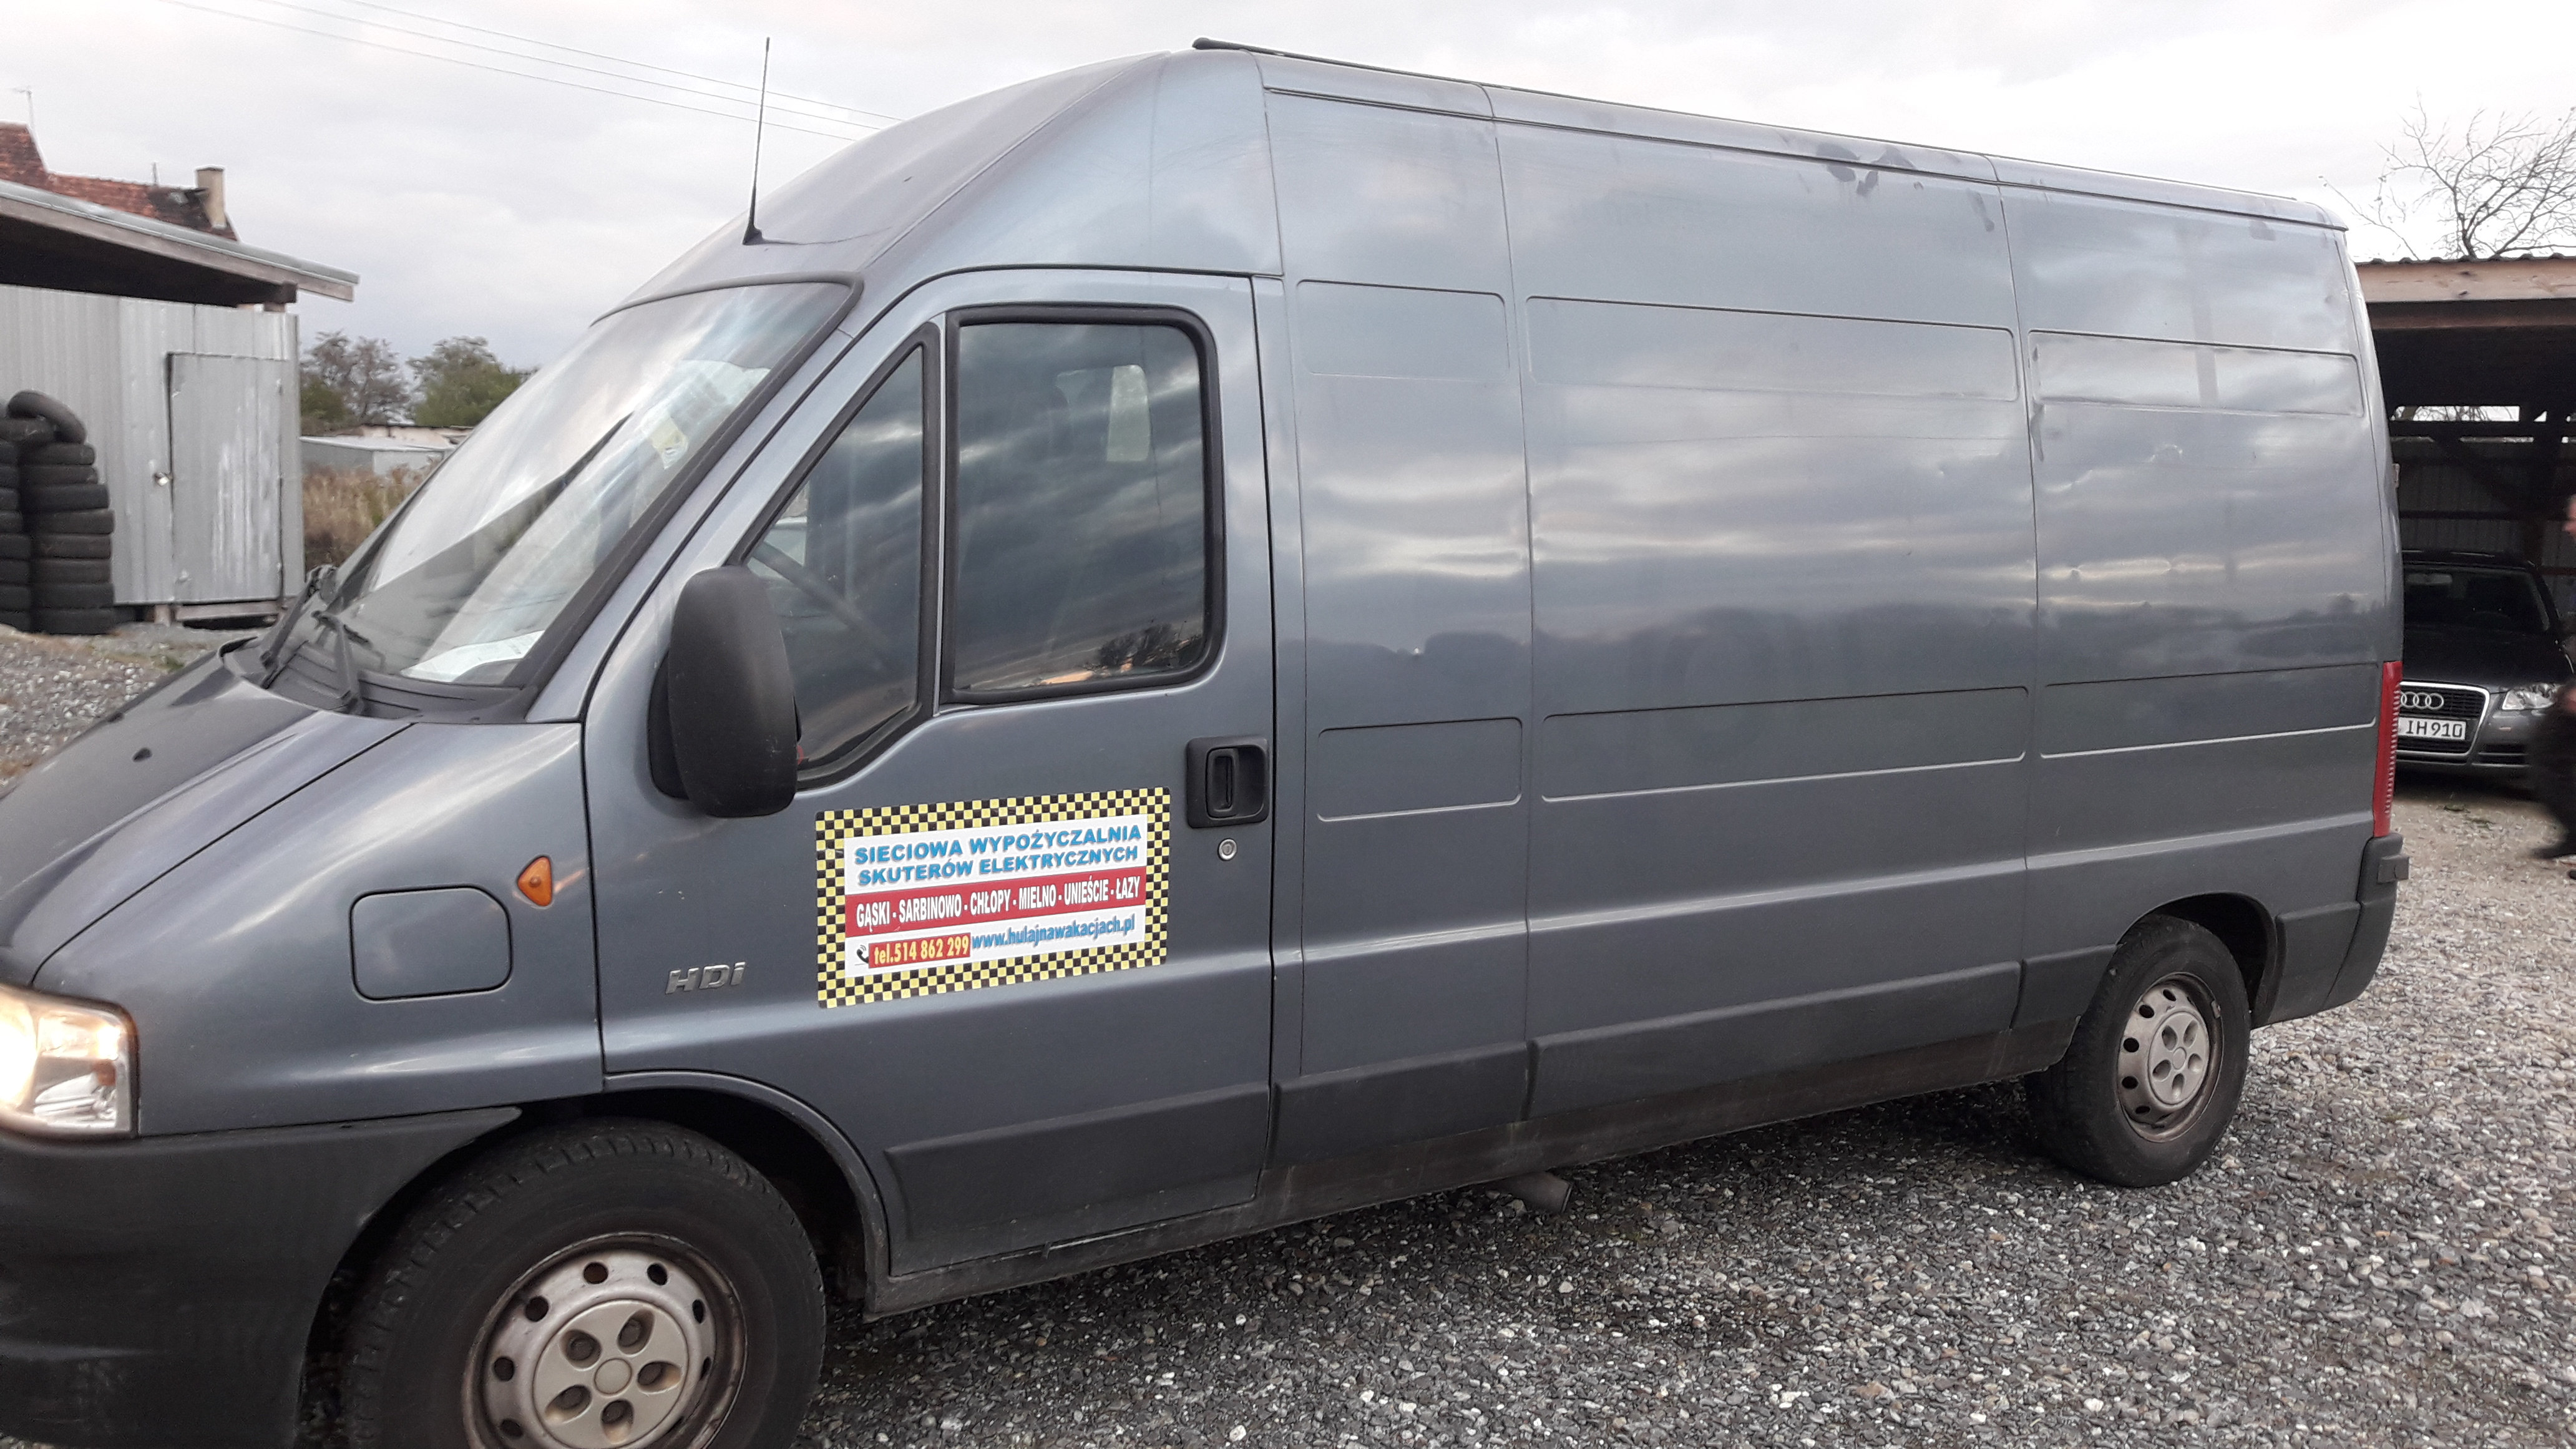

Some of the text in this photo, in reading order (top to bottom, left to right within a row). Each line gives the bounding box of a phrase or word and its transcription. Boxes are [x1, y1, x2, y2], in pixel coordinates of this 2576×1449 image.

[2406, 720, 2462, 738] IH 910
[855, 825, 1142, 864] SIECIOWA WYPOŻYCZALNIA
[859, 846, 1138, 885] SKUTERÓW ELEKTRYCZNYCH
[856, 901, 890, 932] GĄSKI
[899, 894, 962, 924] SARBINOWO
[970, 889, 1011, 915] CHŁOPY
[1019, 884, 1056, 910] MIELNO
[1064, 875, 1109, 905] UNIEŚCIE
[1116, 876, 1140, 899] ŁAZY
[874, 914, 1135, 965] tel.514 862 299 www.hulajnawakacjach.pl
